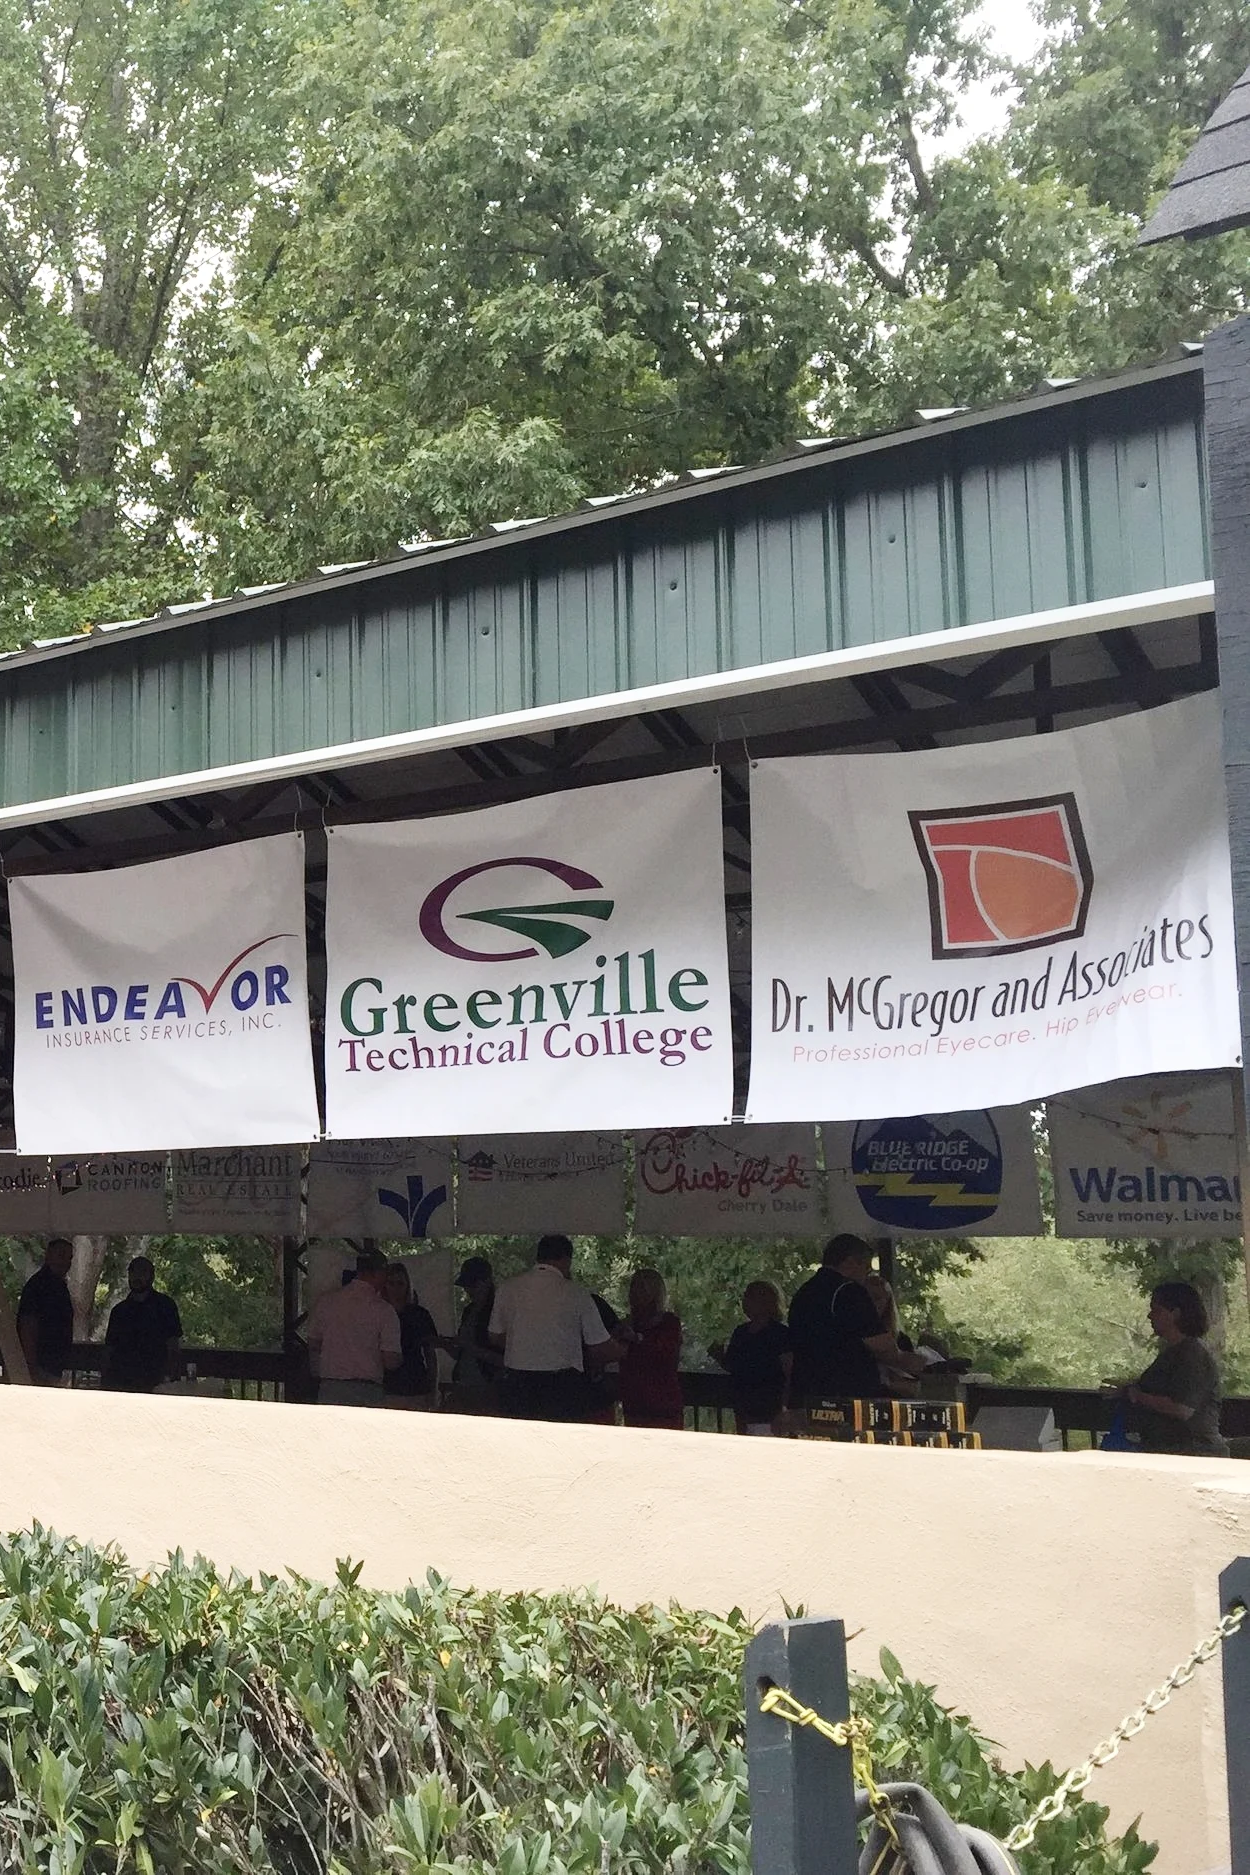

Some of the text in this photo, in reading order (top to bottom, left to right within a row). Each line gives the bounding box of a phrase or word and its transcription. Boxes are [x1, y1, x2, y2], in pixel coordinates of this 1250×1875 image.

[35, 940, 295, 1029] ENDEAVOR
[772, 913, 1214, 1037] Dr. McGregor and Associates
[340, 948, 710, 1037] Greenville
[46, 1012, 282, 1049] INSURANCE SERVICES, INC.
[793, 982, 1183, 1063] Professional Eyecare. Hip Eyewear.
[337, 1018, 713, 1073] Technical College
[868, 1140, 969, 1156] BLUE RIDGE
[177, 1151, 293, 1177] Marchant
[504, 1153, 561, 1170] Veterans
[872, 1157, 989, 1174] Electric Co-op
[88, 1176, 161, 1192] ROOFING
[177, 1183, 292, 1197] REAL ESTATE
[718, 1200, 767, 1214] Cherry
[1077, 1210, 1114, 1222] Save
[1117, 1210, 1179, 1225] money.
[1184, 1209, 1219, 1222] Live
